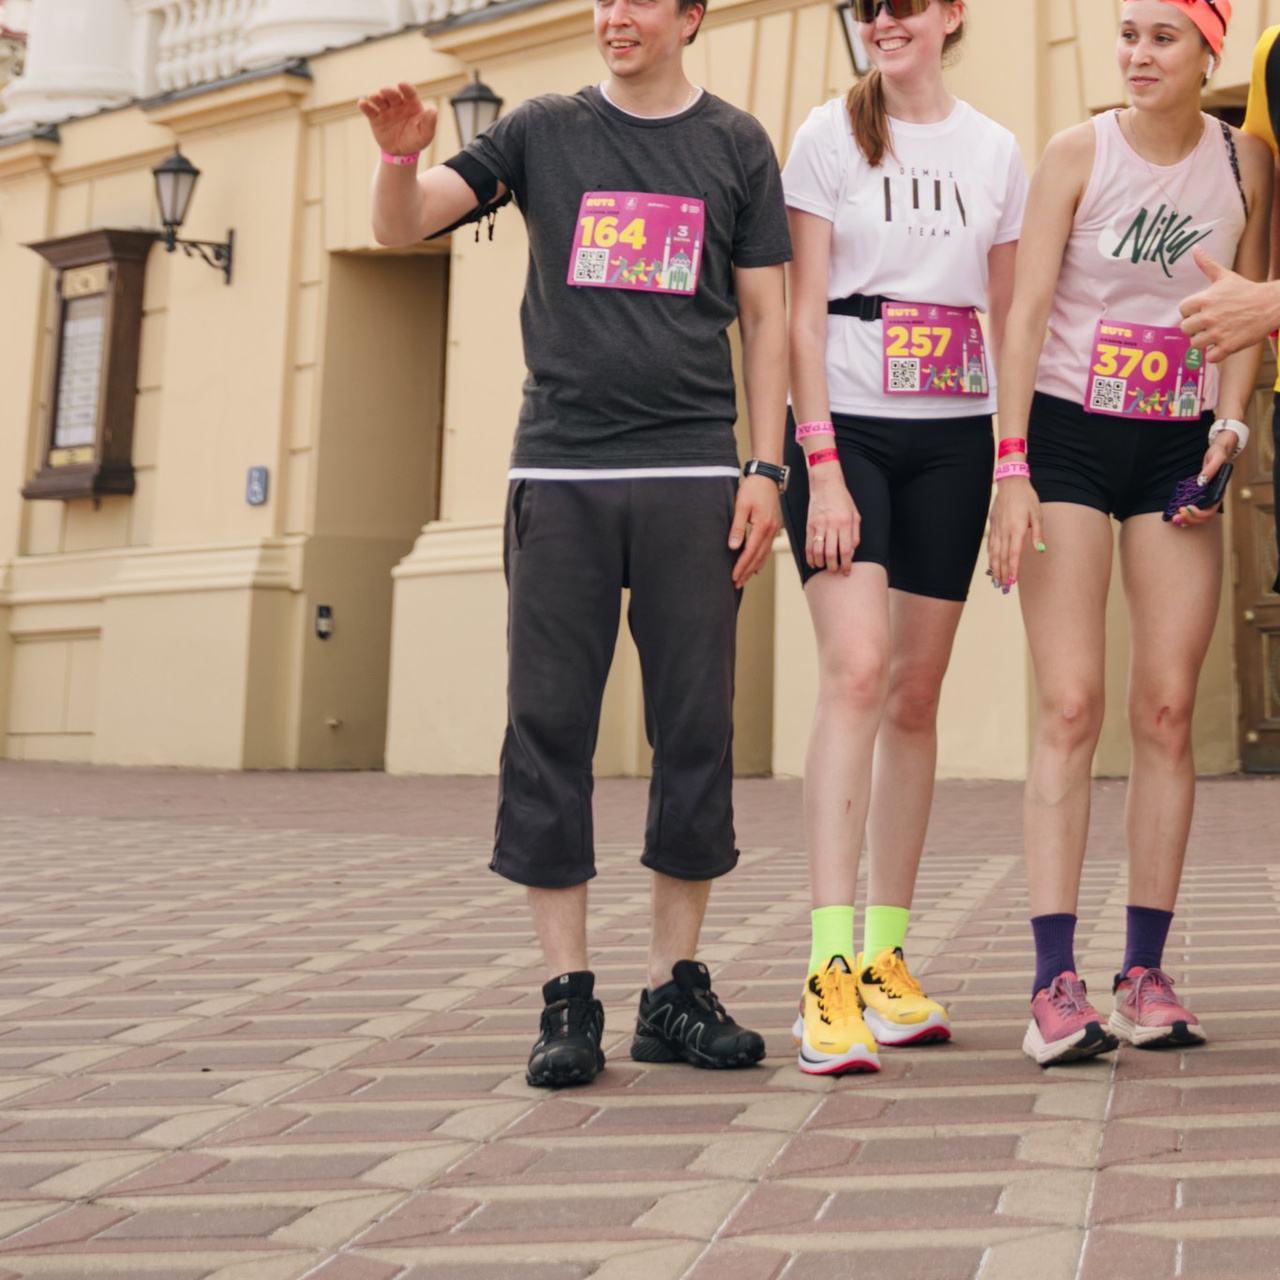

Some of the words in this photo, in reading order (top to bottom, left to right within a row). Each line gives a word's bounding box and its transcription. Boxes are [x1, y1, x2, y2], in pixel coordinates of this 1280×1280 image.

[580, 216, 647, 250] 164
[677, 225, 689, 237] 3
[907, 226, 951, 238] TEAM
[1100, 325, 1133, 338] RUTS
[886, 326, 952, 358] 257
[1189, 348, 1199, 360] 2
[1092, 343, 1169, 382] 370
